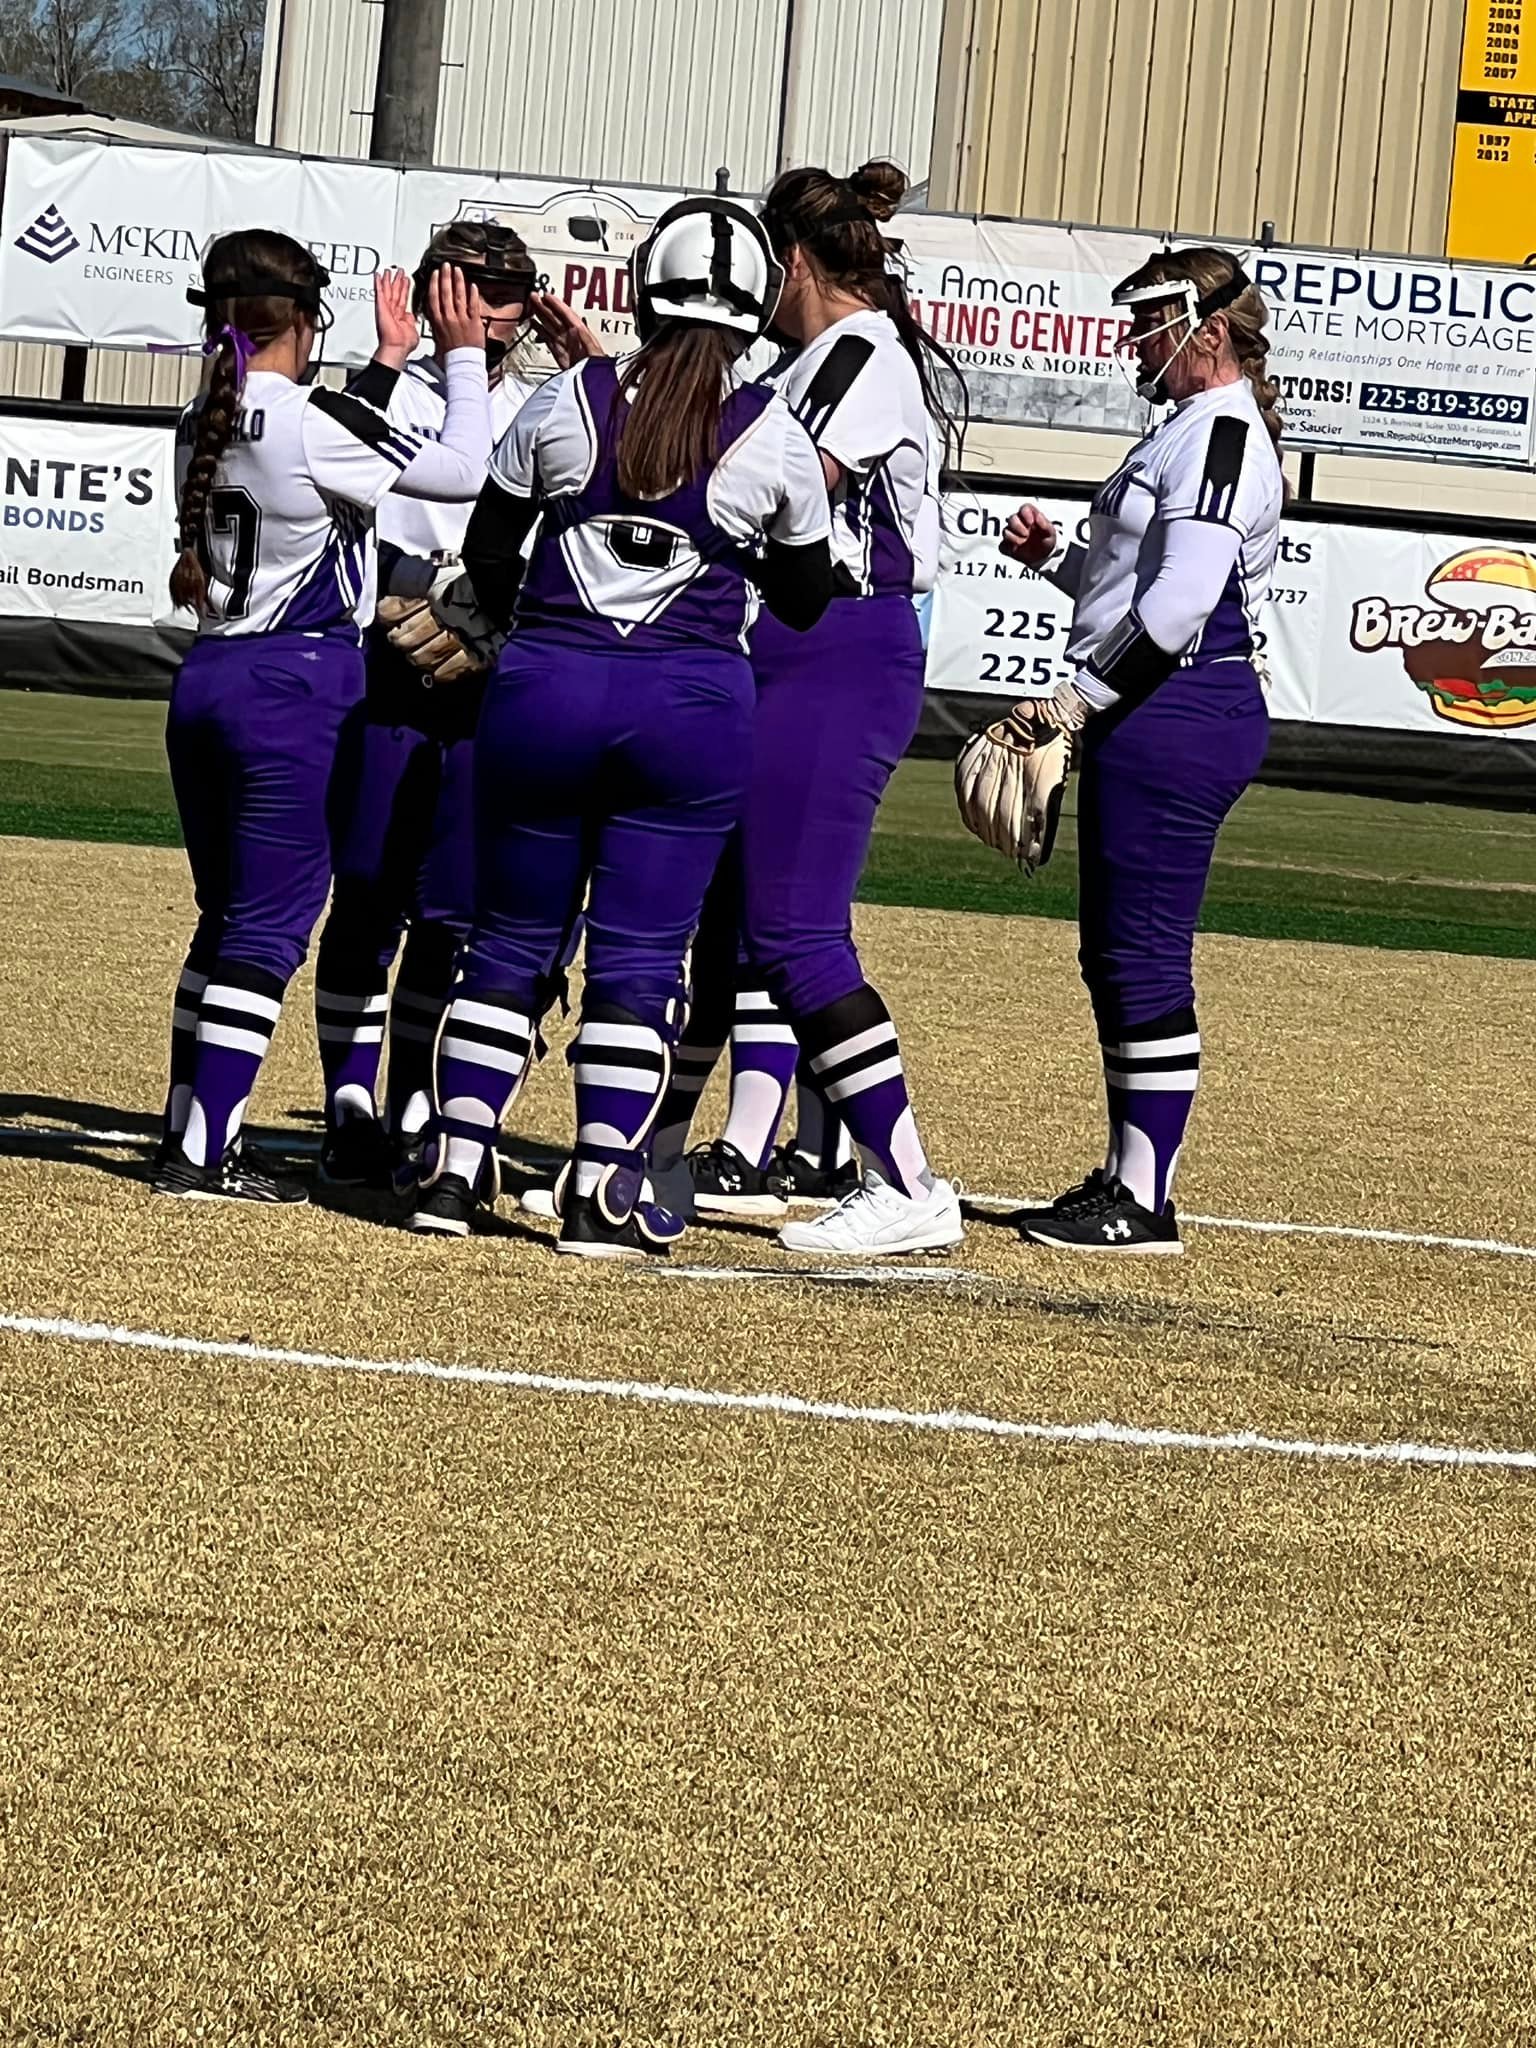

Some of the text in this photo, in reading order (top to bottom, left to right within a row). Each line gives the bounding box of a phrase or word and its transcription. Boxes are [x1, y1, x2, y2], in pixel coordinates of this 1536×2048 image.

[1489, 7, 1521, 19] 2003
[1488, 22, 1520, 35] 2004
[1484, 66, 1516, 79] 2007
[1488, 96, 1535, 110] STATE
[1476, 148, 1509, 162] 2012
[83, 264, 174, 285] ENGINEERS
[941, 265, 1061, 308] Amant
[325, 286, 376, 303] NNERS
[563, 264, 634, 314] PAD
[1254, 259, 1536, 323] REPUBLIC
[600, 319, 637, 336] KIT
[1009, 309, 1138, 362] CENTER
[1269, 306, 1535, 354] TATE MORTGAGE
[1021, 355, 1036, 371] &
[1042, 356, 1114, 378] MORE!
[1308, 348, 1393, 368] Relationships
[1396, 355, 1422, 370] One
[1425, 357, 1462, 373] Home
[1465, 363, 1479, 375] at
[1481, 365, 1490, 376] a
[1268, 374, 1353, 404] TORS!
[1365, 386, 1523, 420] 225-819-3699
[1299, 420, 1343, 435] Saucier
[5, 457, 154, 506] NTE'S
[3, 504, 105, 534] BONDS
[27, 567, 144, 595] Bondsman
[953, 560, 988, 578] 117
[994, 563, 1013, 580] N.
